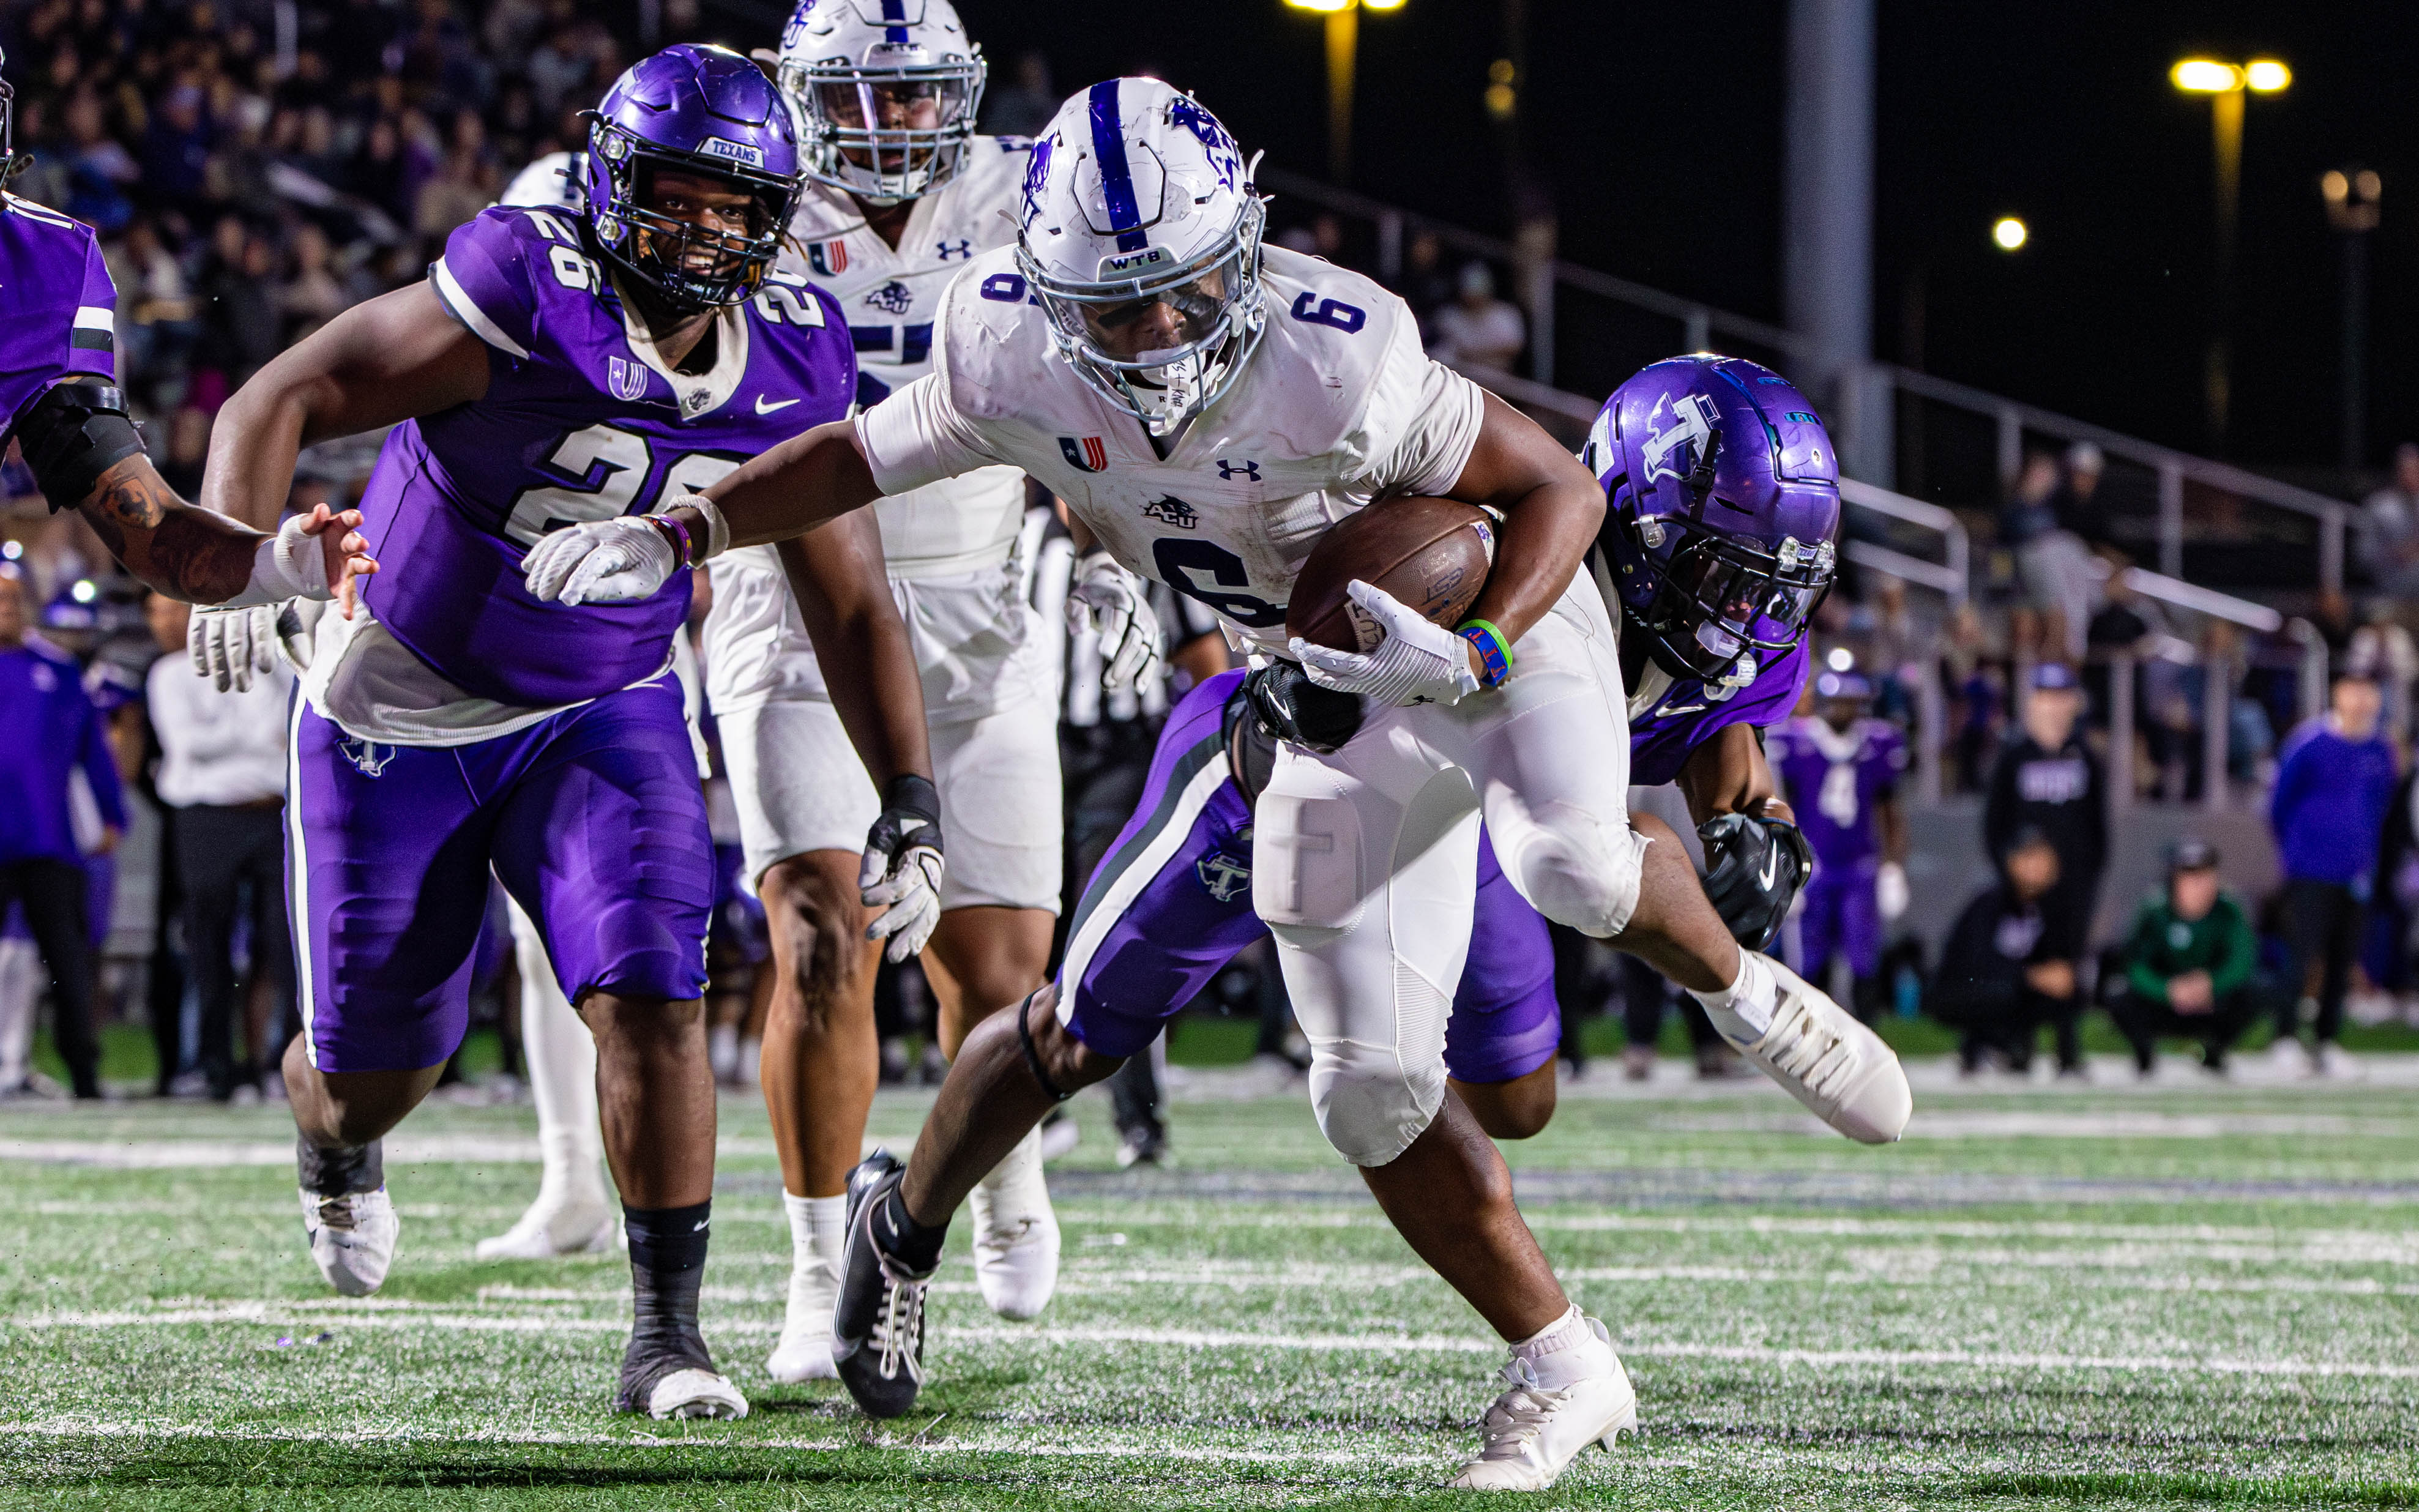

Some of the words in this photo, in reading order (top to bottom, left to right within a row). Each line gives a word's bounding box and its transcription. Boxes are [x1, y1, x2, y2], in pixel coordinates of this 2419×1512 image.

[713, 140, 756, 163] TEXANS
[1109, 250, 1161, 270] WTB
[865, 289, 912, 315] ACU
[1290, 291, 1366, 335] 6
[1142, 501, 1199, 530] ACU
[1152, 537, 1289, 628] 6
[1817, 763, 1859, 829] 4
